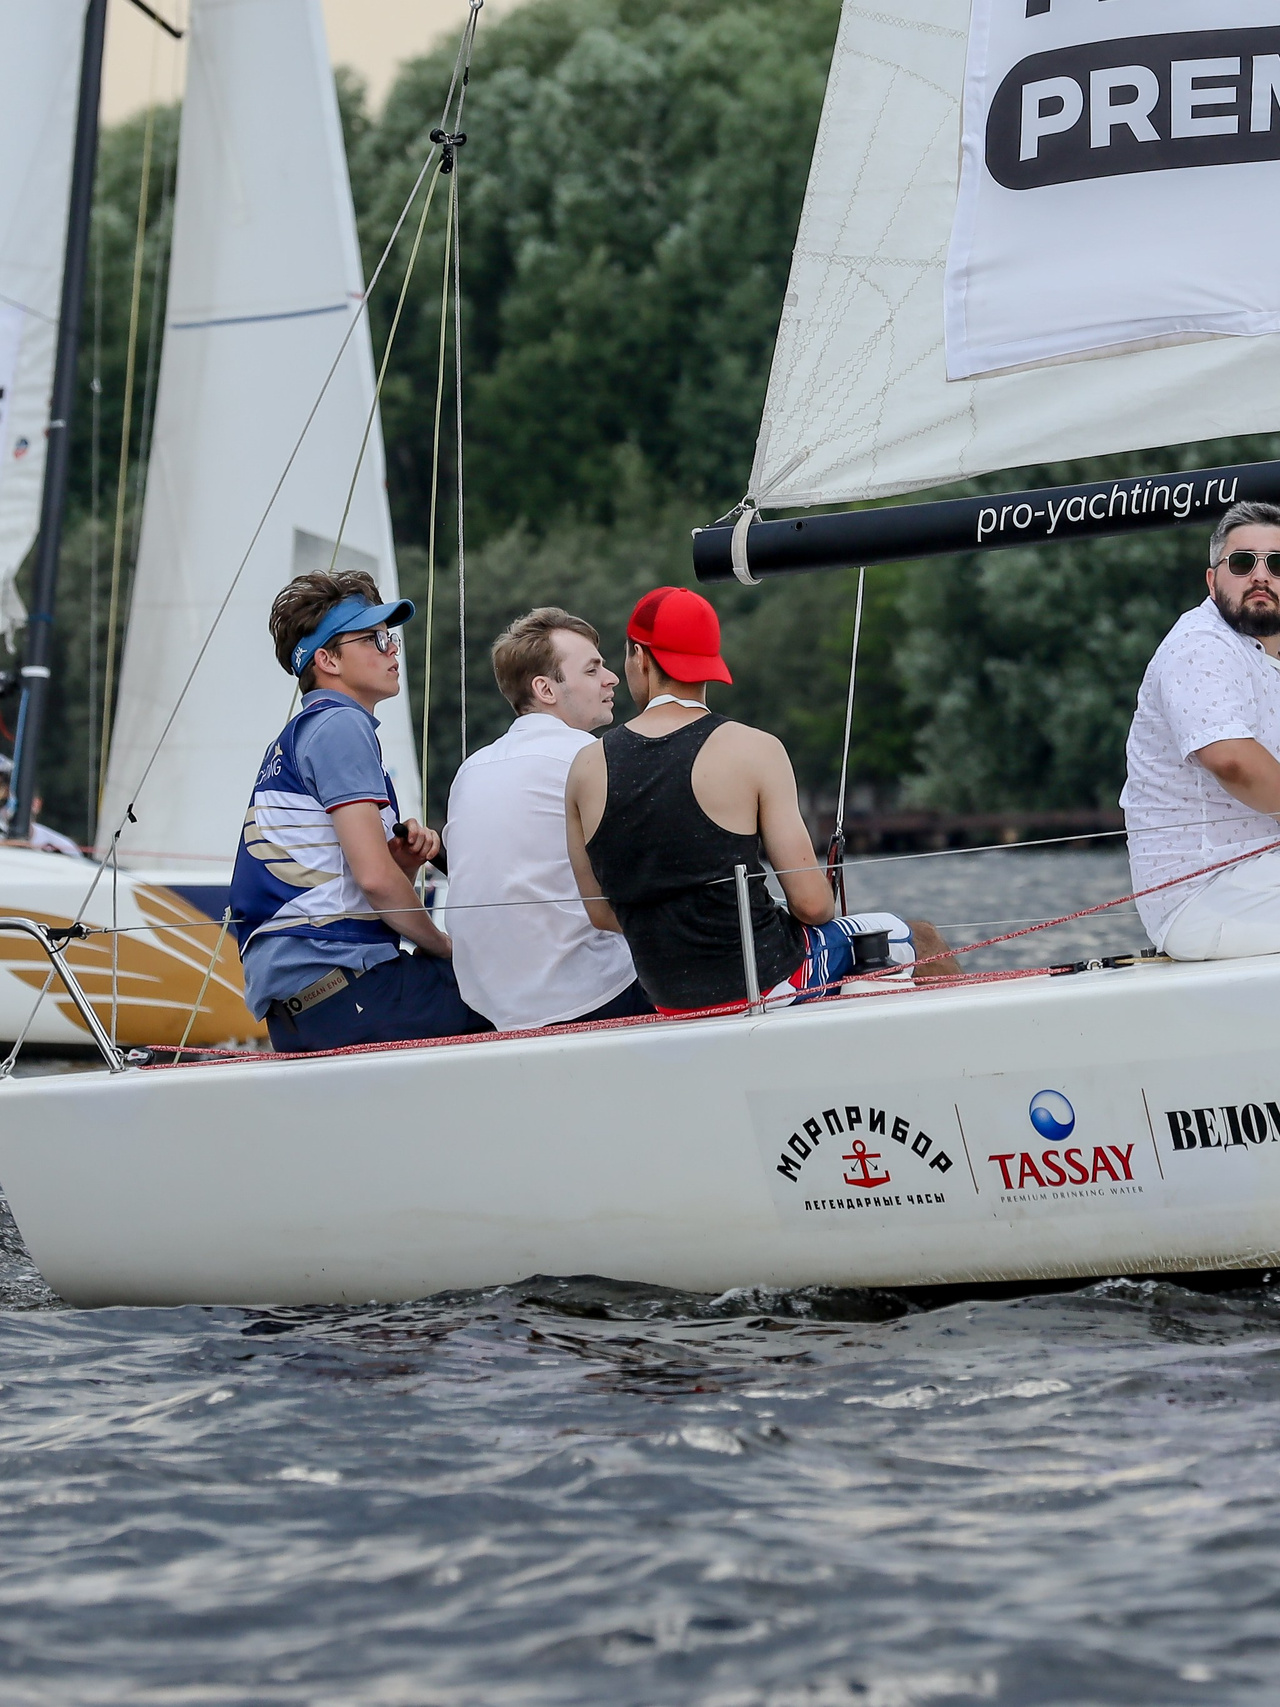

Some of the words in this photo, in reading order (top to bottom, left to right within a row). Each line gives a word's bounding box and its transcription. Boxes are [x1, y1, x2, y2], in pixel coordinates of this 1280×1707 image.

[977, 477, 1238, 542] pro-yachting.ru
[303, 987, 326, 1002] OCEAN
[777, 1106, 953, 1183] МОРПРИБОР
[988, 1143, 1135, 1190] TASSAY
[804, 1195, 902, 1211] ЛЕГЕНДАРНЫЕ
[906, 1192, 946, 1205] ЧАСЫ
[1000, 1192, 1048, 1204] PREMIUM
[1052, 1188, 1106, 1200] DRINKING
[1109, 1185, 1145, 1196] WATER
